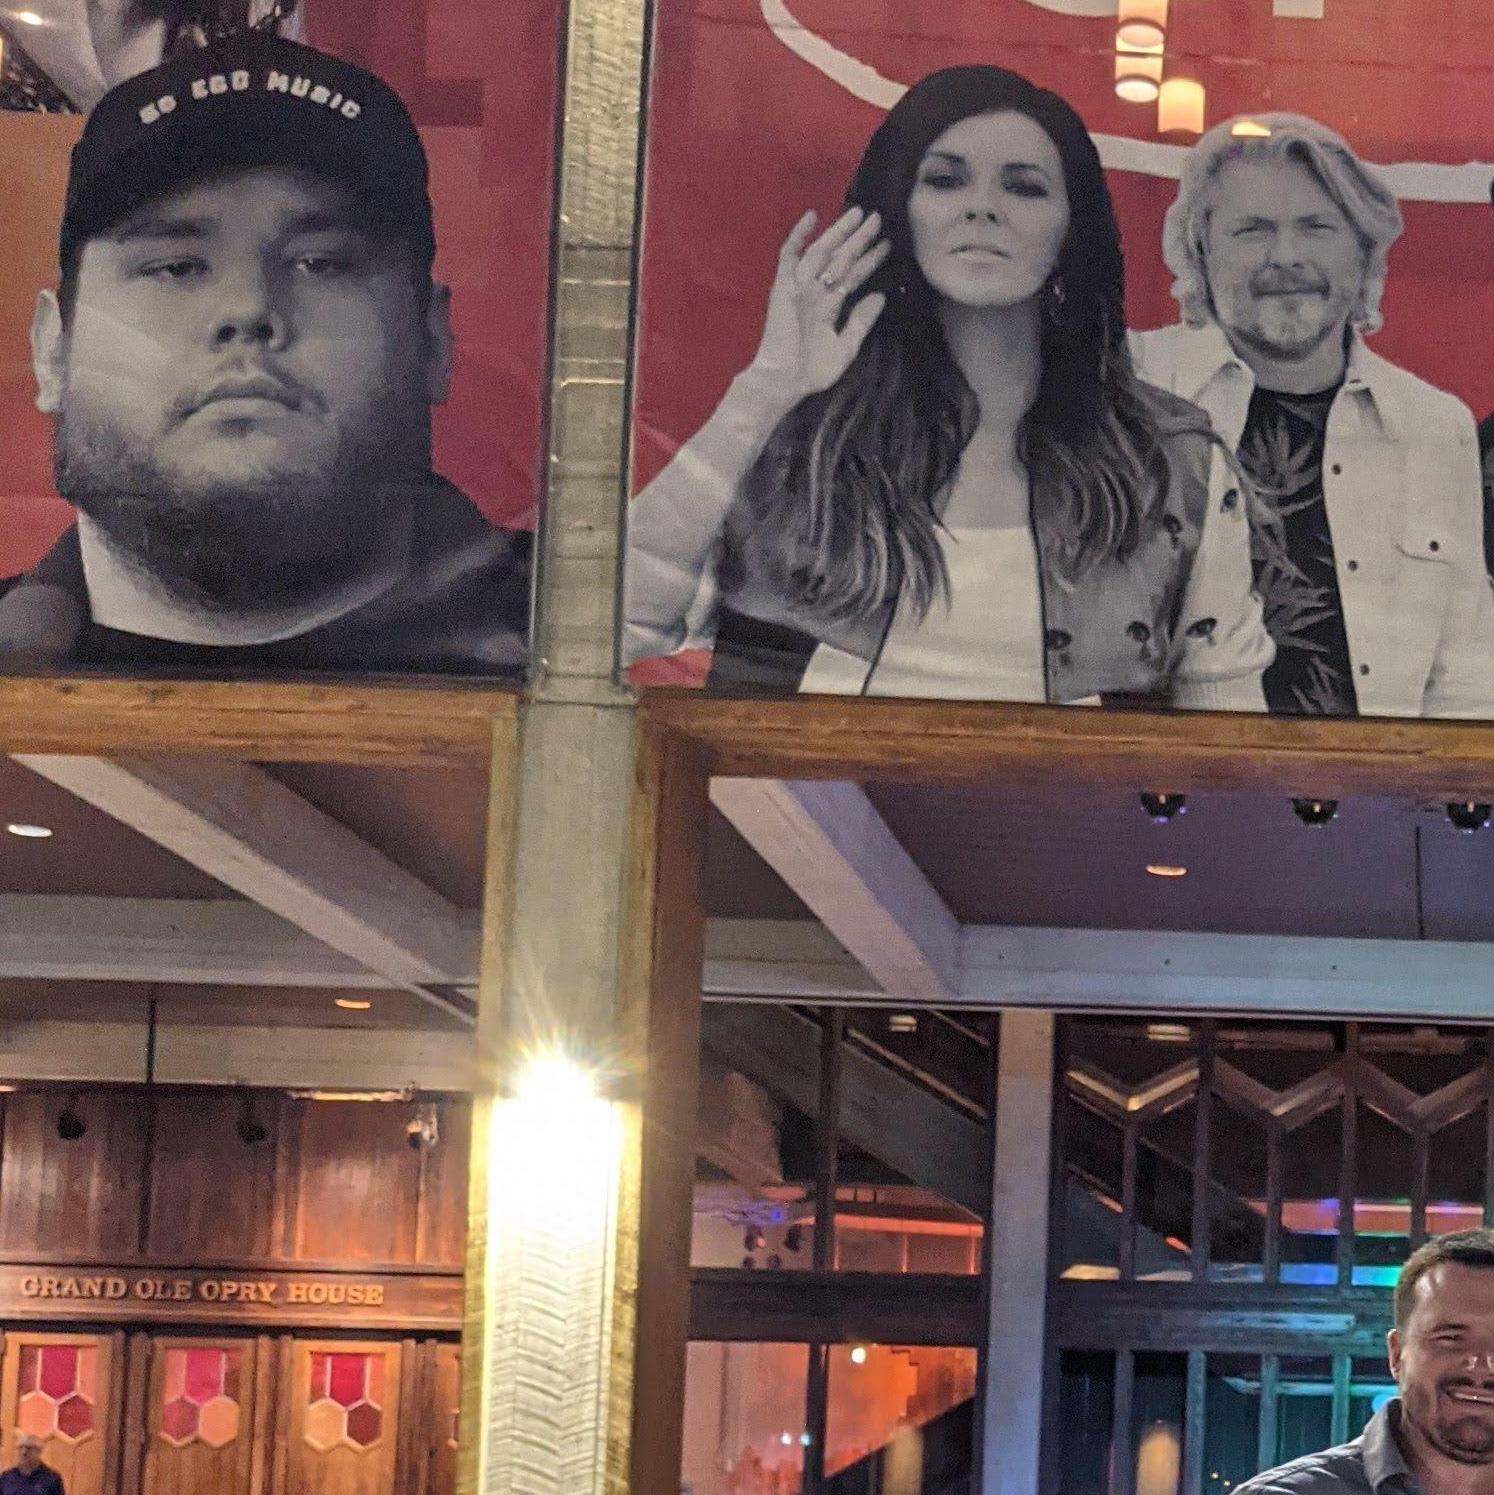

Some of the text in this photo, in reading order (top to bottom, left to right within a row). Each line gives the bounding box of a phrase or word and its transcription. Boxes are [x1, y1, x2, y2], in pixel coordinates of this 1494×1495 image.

[267, 71, 361, 119] MUSIC
[22, 1276, 385, 1306] GRAND OLE OPRY HOUSE
